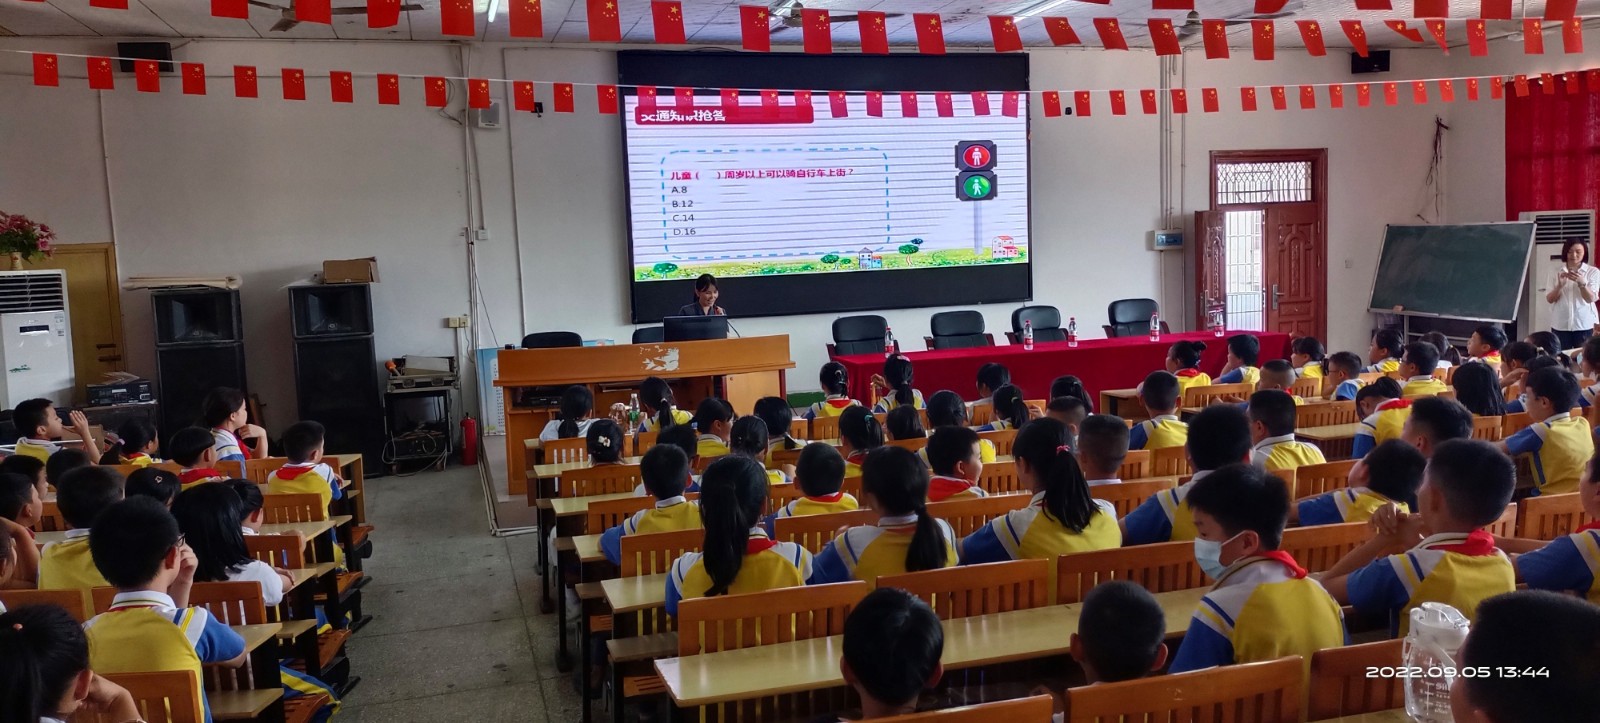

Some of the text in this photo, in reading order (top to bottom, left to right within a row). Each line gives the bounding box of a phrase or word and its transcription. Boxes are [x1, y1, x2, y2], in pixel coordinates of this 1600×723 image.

[671, 186, 688, 194] A.8
[672, 200, 694, 208] B.12
[672, 214, 695, 222] C.14
[673, 228, 696, 236] D.16
